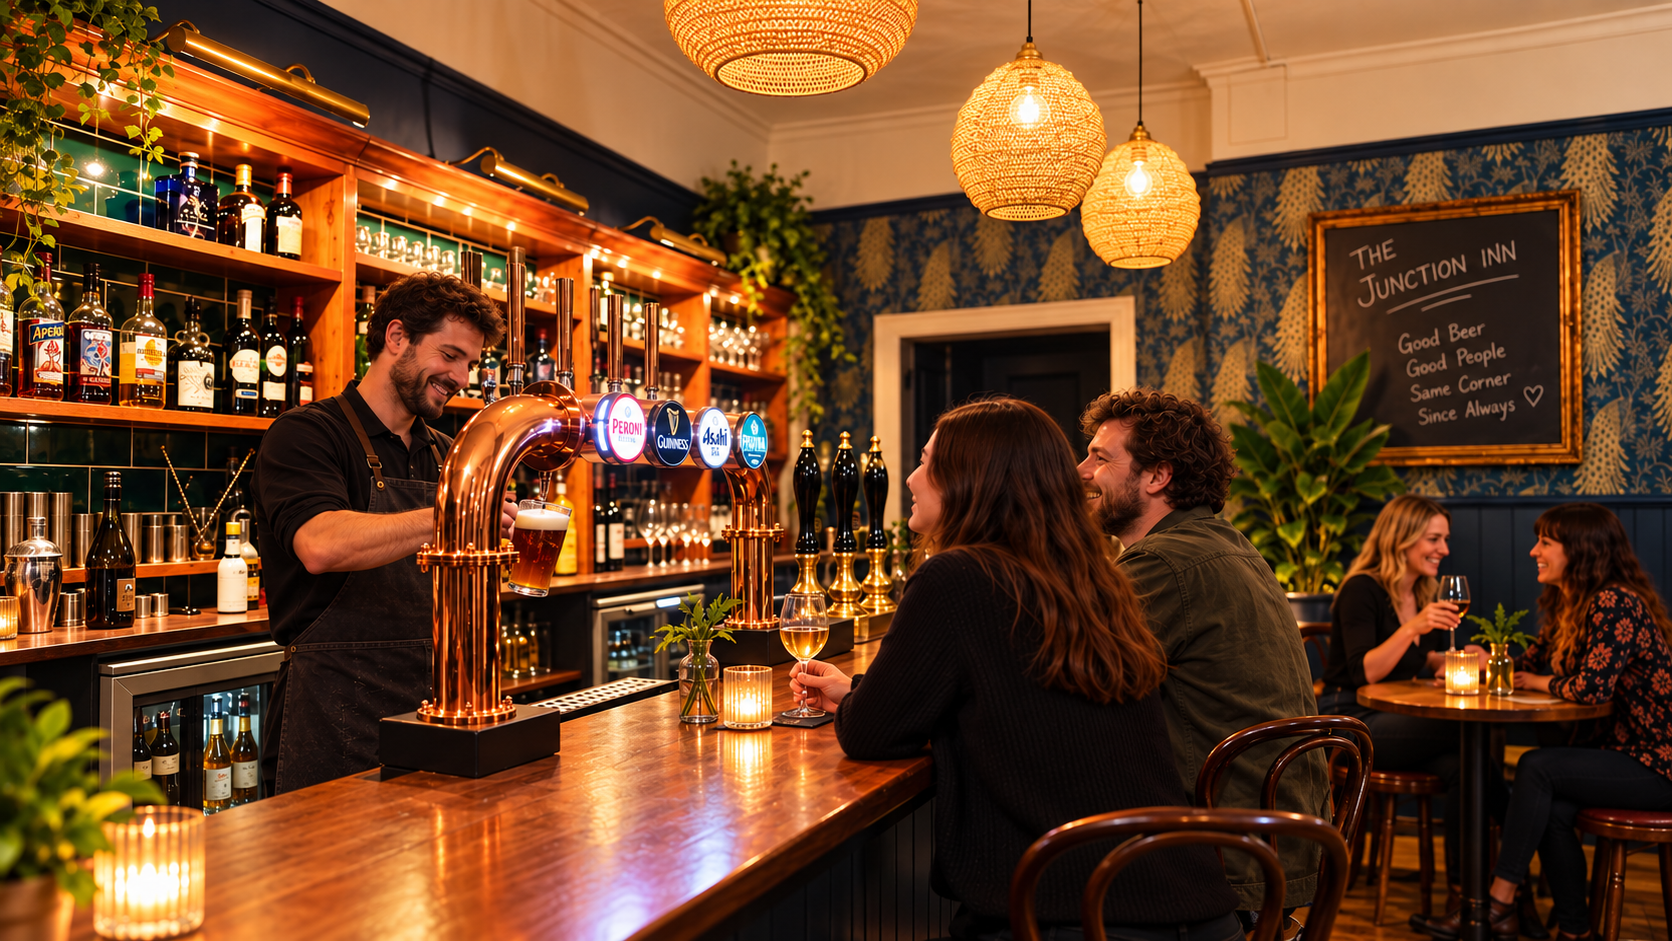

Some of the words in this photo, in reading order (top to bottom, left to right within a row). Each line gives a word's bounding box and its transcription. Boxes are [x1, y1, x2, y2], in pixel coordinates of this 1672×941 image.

[1349, 238, 1397, 270] THE
[1357, 254, 1467, 308] JUNCTION
[1481, 240, 1517, 268] INN
[1398, 327, 1441, 354] Good
[1448, 323, 1485, 343] Beer
[1406, 352, 1447, 377] Good
[1456, 342, 1506, 368] People
[1410, 384, 1451, 403] Same
[1458, 373, 1511, 394] Corner
[612, 418, 642, 436] PERONI
[1418, 407, 1457, 425] Since
[1465, 399, 1516, 421] Always
[657, 434, 689, 450] GUINNESS
[702, 426, 728, 447] Asahi
